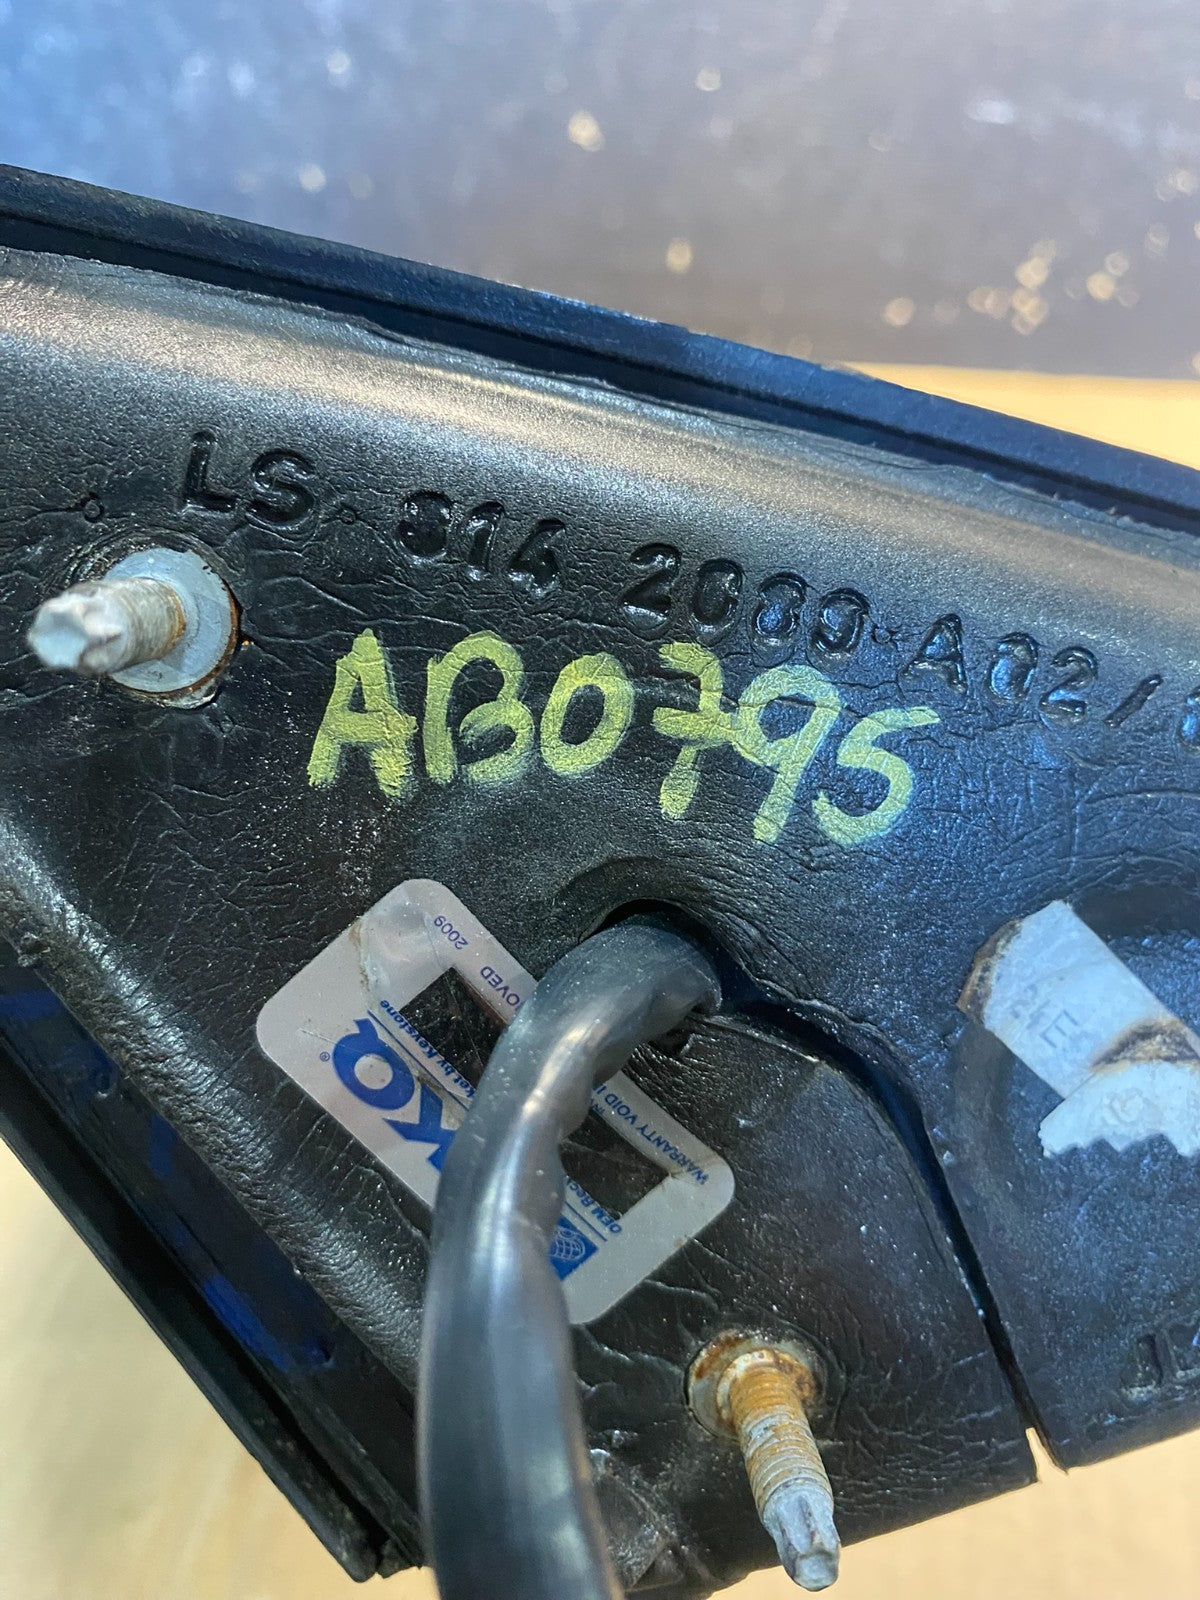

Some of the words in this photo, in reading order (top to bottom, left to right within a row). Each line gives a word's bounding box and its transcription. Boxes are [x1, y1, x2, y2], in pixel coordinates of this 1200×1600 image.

[182, 431, 316, 525] LS
[433, 915, 469, 950] 2009
[480, 965, 523, 1011] OVED
[379, 999, 439, 1059] Keystone
[437, 1059, 455, 1076] by
[332, 1017, 458, 1174] KQ
[604, 1093, 639, 1125] VOID
[635, 1123, 710, 1186] WARRANTY
[591, 1207, 622, 1233] OEM
